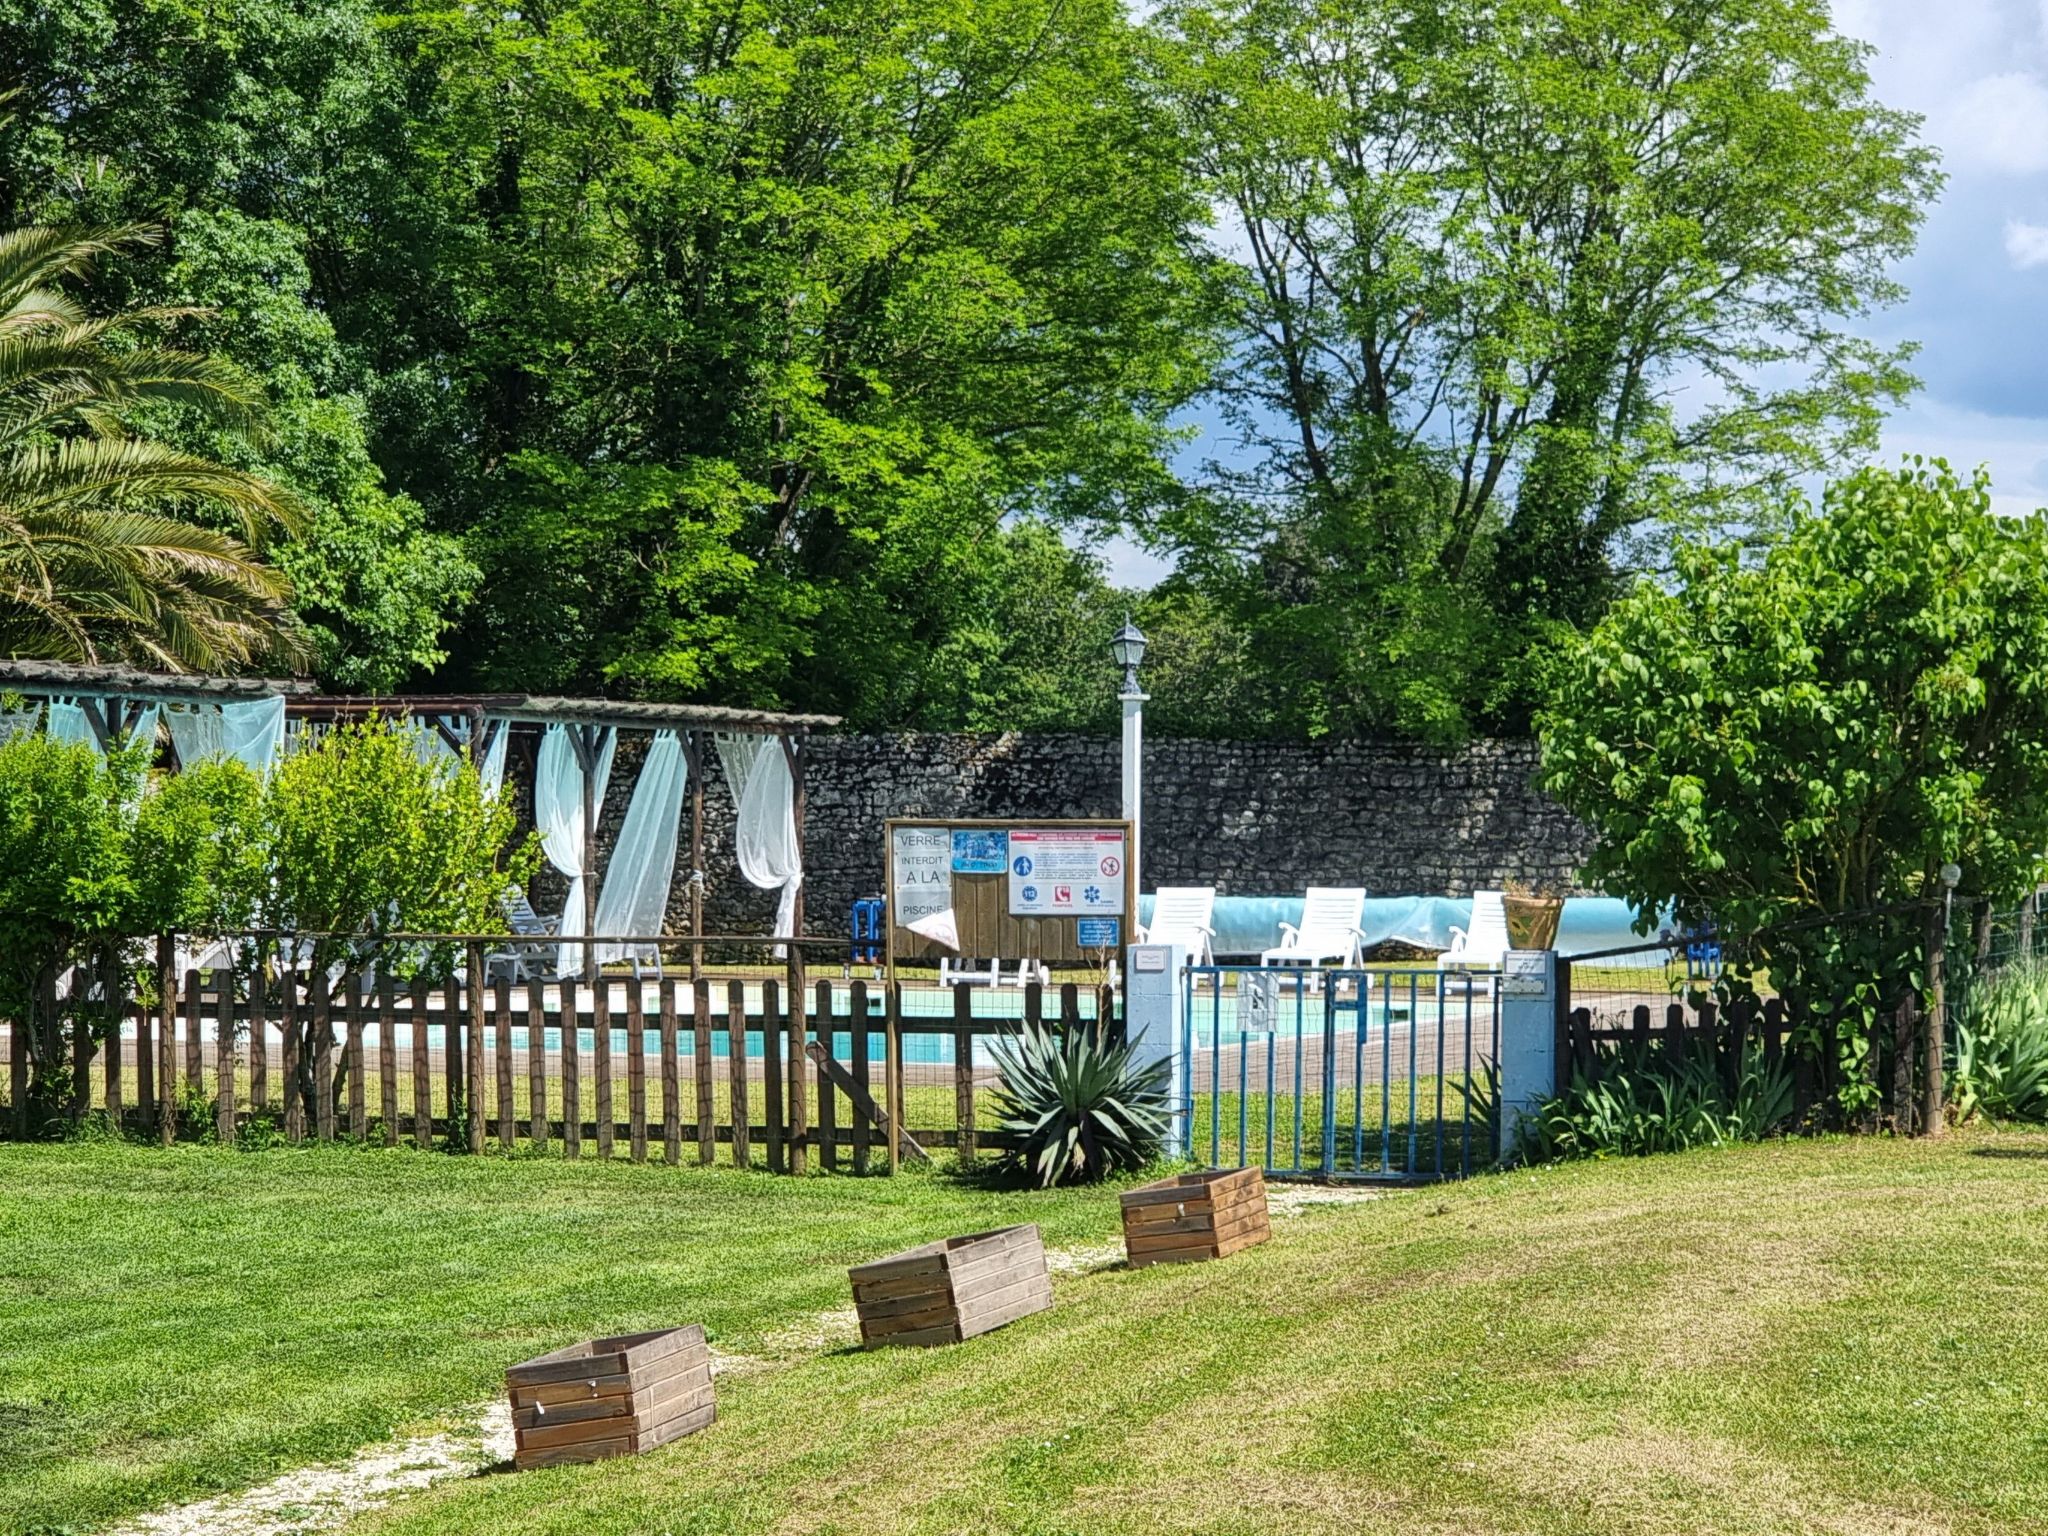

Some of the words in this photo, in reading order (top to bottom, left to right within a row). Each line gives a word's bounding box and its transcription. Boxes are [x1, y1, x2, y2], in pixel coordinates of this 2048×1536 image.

[901, 835, 940, 846] VERRE
[902, 856, 943, 865] INTERDIT
[906, 871, 916, 884] A
[921, 870, 940, 884] LA
[903, 905, 943, 915] PISCINE
